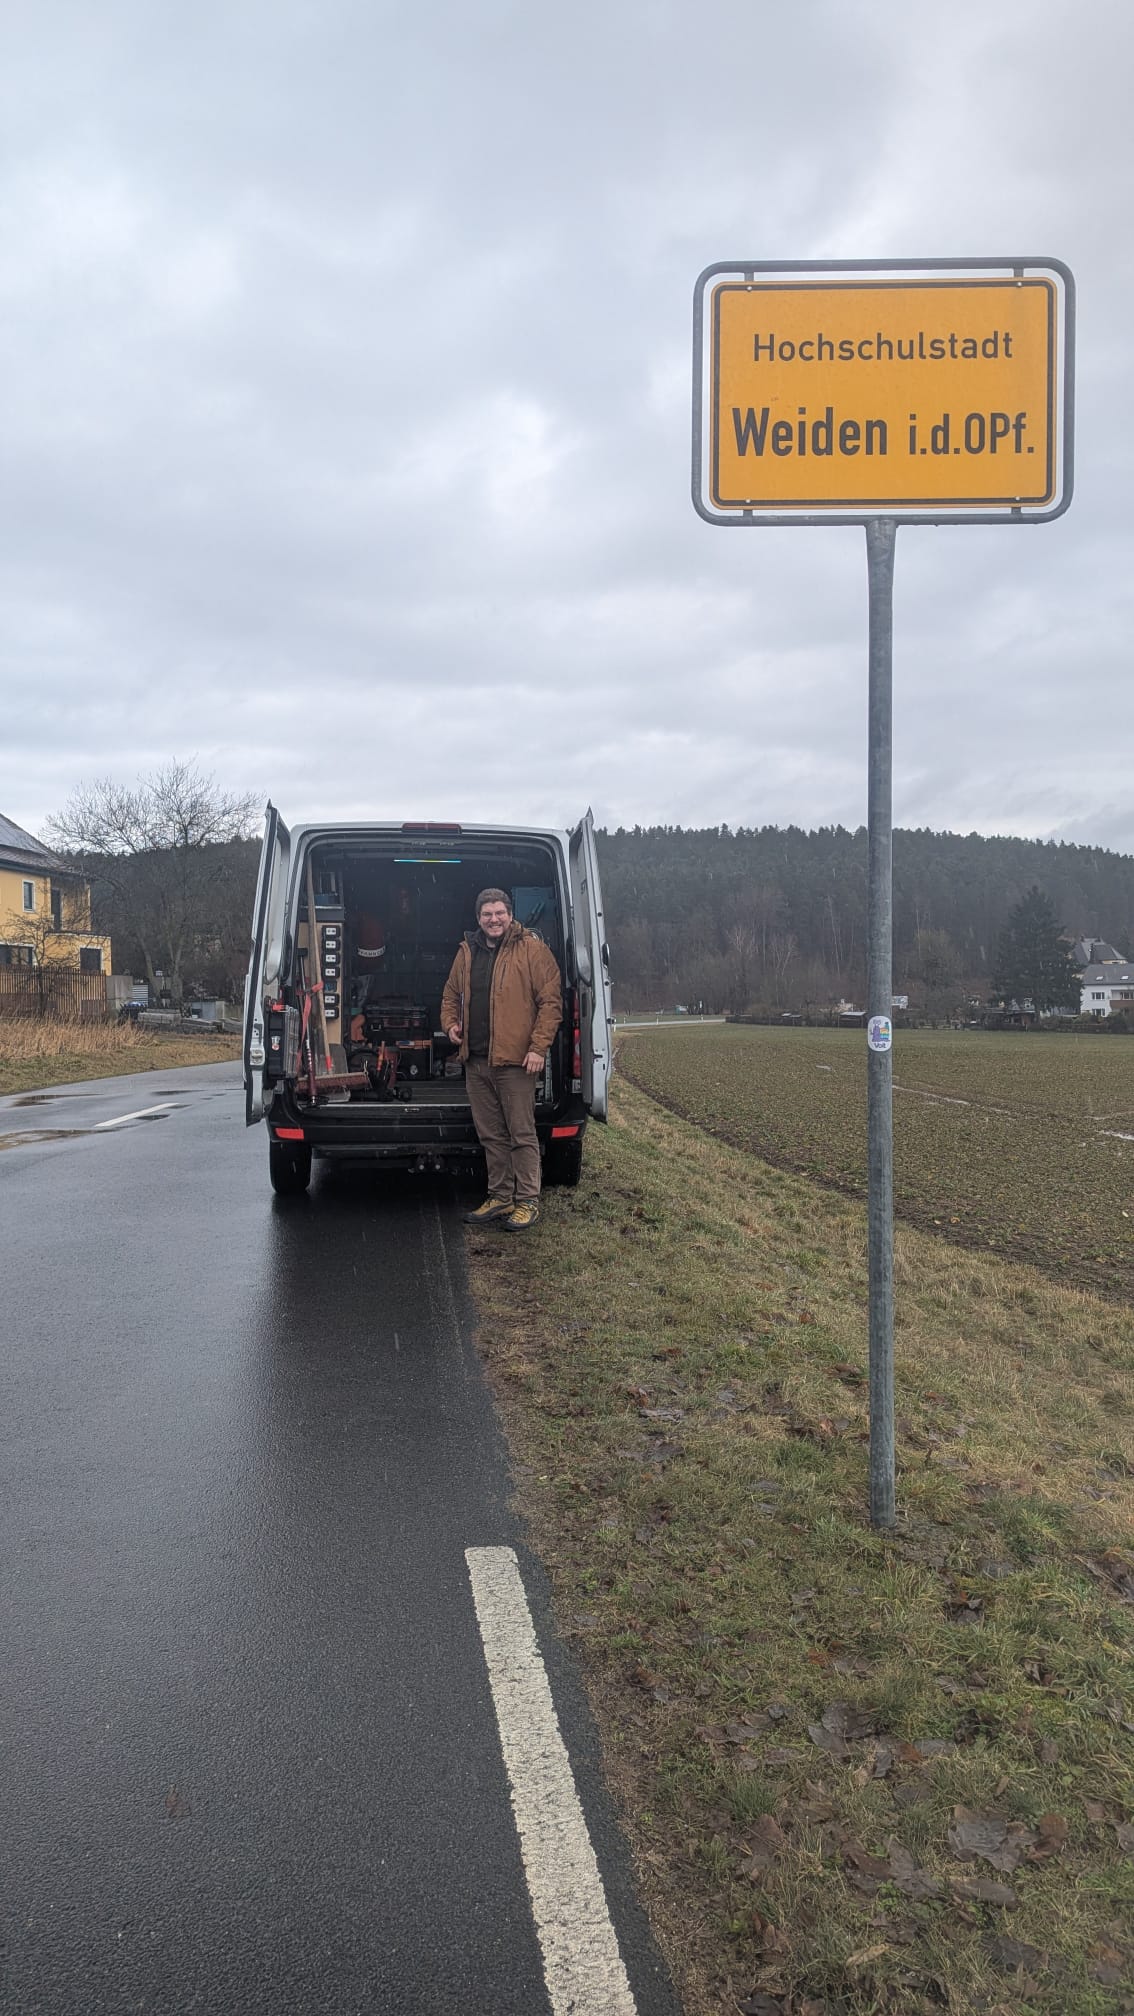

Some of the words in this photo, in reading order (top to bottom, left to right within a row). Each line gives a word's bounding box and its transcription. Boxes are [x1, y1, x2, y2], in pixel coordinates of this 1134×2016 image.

[753, 331, 1013, 362] Hochschulstadt
[732, 407, 888, 457] Weiden
[909, 412, 1035, 455] i.d.OPf.
